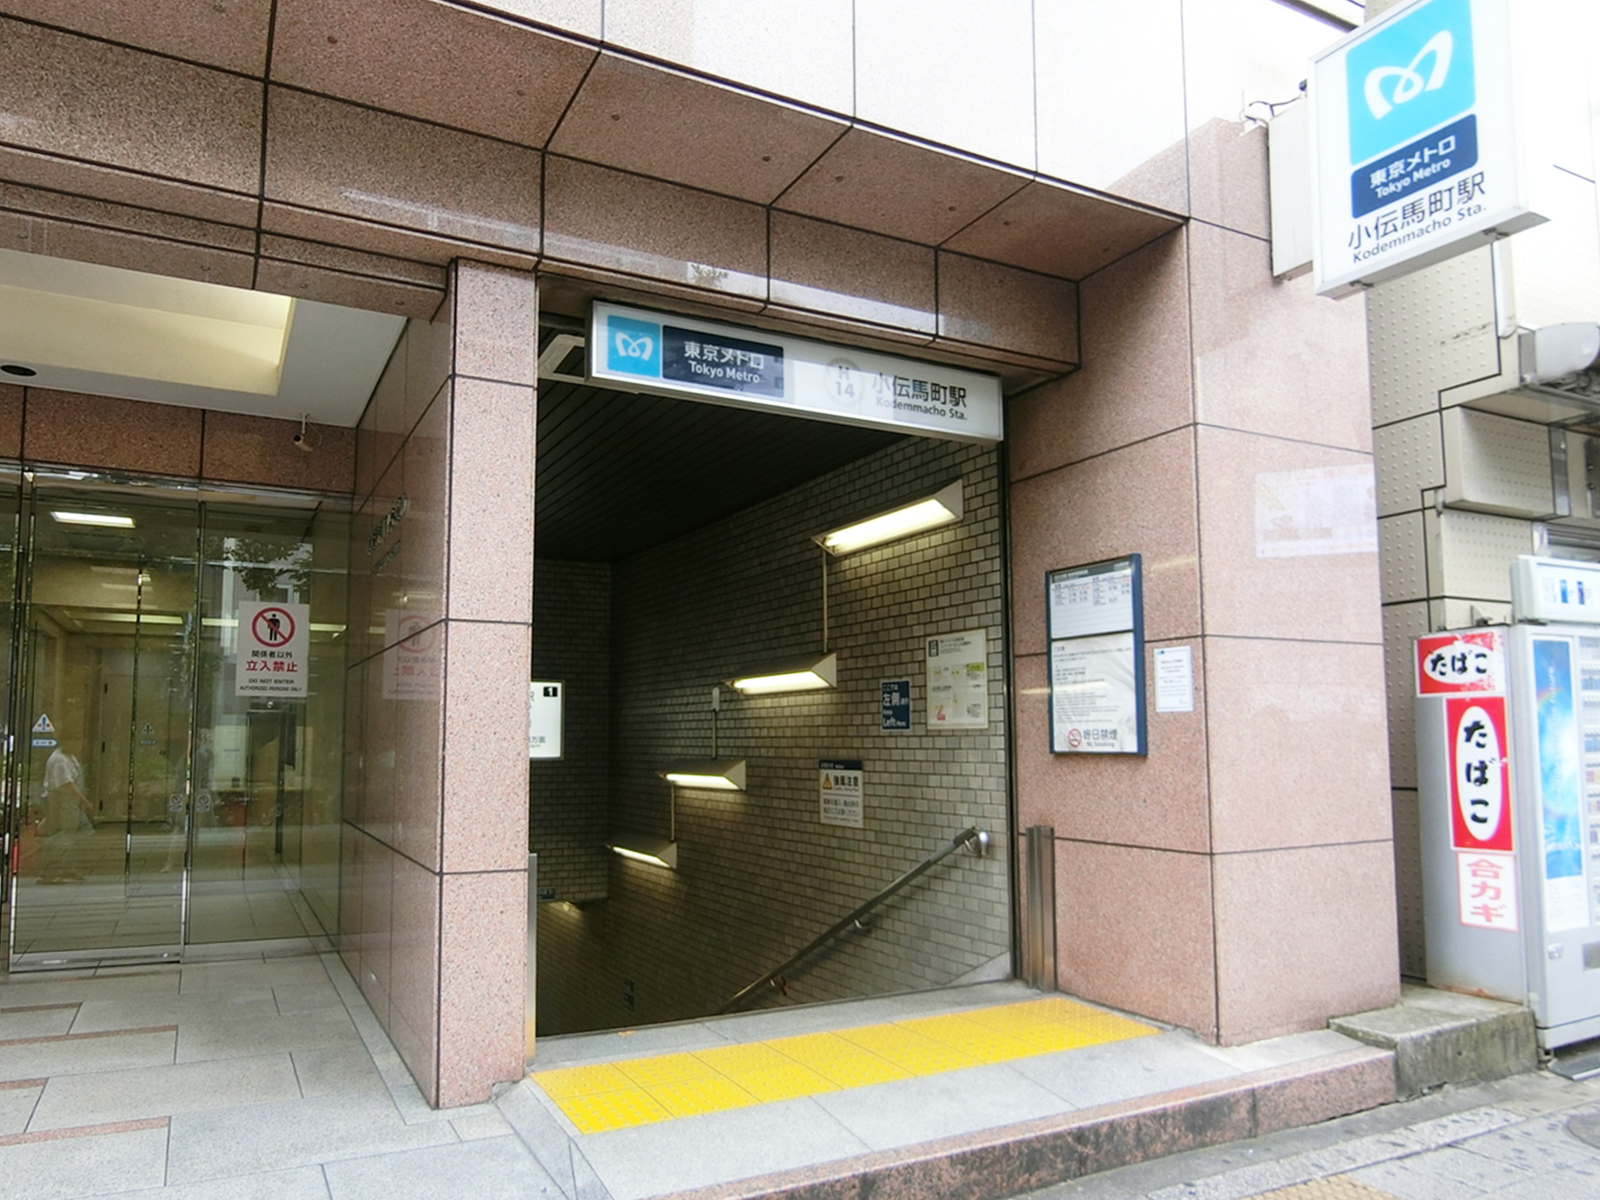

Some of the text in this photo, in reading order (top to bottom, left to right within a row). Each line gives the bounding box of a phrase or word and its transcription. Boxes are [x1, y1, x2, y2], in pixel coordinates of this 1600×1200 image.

[1369, 135, 1456, 189] 東京メトロ
[1375, 158, 1451, 198] Tokyo Metro
[1348, 171, 1486, 250] 小伝馬町駅
[1353, 203, 1487, 263] Kodemmacho Sta.
[683, 341, 764, 369] 東京メトロ
[688, 360, 760, 383] Tokyo Metro
[838, 365, 850, 380] H
[835, 381, 855, 398] 14
[872, 372, 967, 408] 小伝馬町駅
[876, 395, 967, 420] Kodemmacho Sta.
[246, 660, 298, 673] 立入禁止
[251, 650, 293, 659] 関係者以外
[1430, 649, 1488, 676] たばこ
[547, 687, 553, 697] 1
[1463, 720, 1497, 824] たばこ
[1466, 858, 1505, 923] 合カギ
